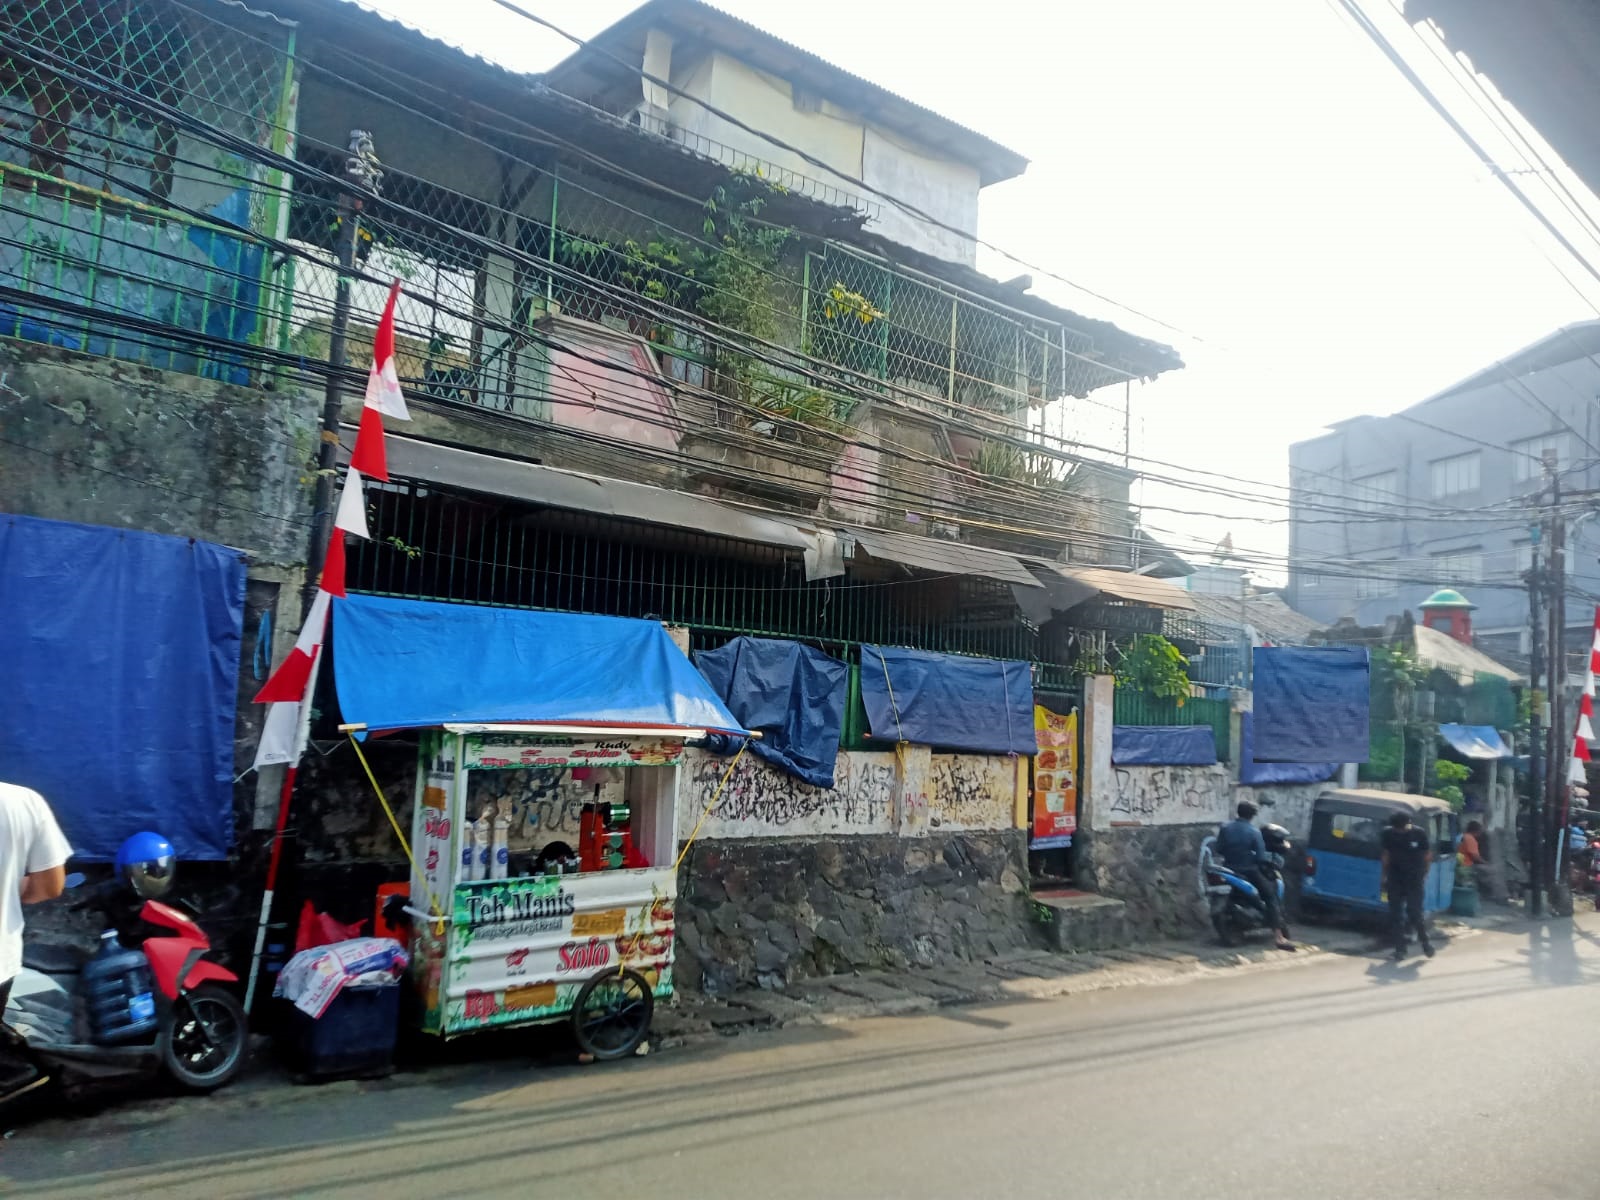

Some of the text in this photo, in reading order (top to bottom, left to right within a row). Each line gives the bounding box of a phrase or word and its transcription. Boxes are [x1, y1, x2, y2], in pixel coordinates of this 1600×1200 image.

[569, 748, 622, 759] Solo
[594, 740, 632, 751] Rudy
[466, 886, 575, 928] Teh Manis
[557, 937, 610, 973] Solo
